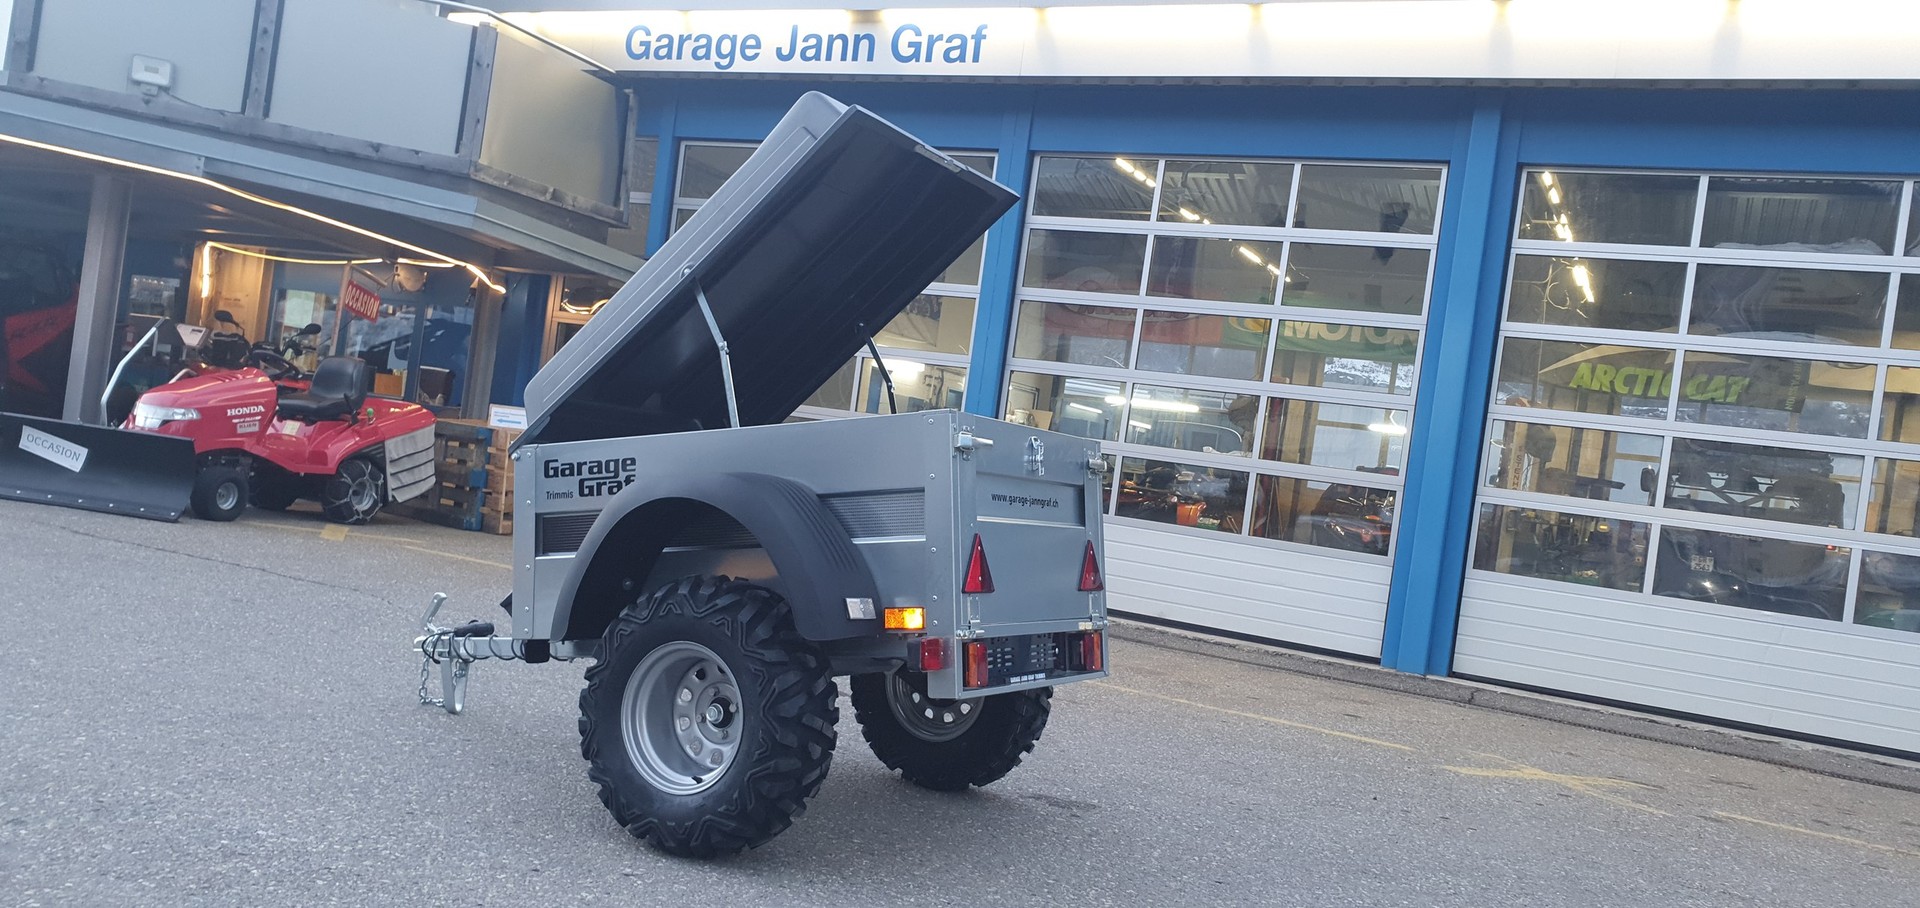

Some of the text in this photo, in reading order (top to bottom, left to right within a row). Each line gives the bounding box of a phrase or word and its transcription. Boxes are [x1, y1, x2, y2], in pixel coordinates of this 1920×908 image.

[625, 23, 989, 71] Garage Jann Graf
[345, 284, 380, 319] OCCASION
[1569, 362, 1749, 402] ARCTIC CAT
[227, 405, 265, 417] HONDA
[26, 433, 81, 462] OCCASION
[544, 457, 636, 479] Garage
[546, 490, 574, 500] Trimmis
[991, 493, 1059, 509] www.garage-janngraf.ch
